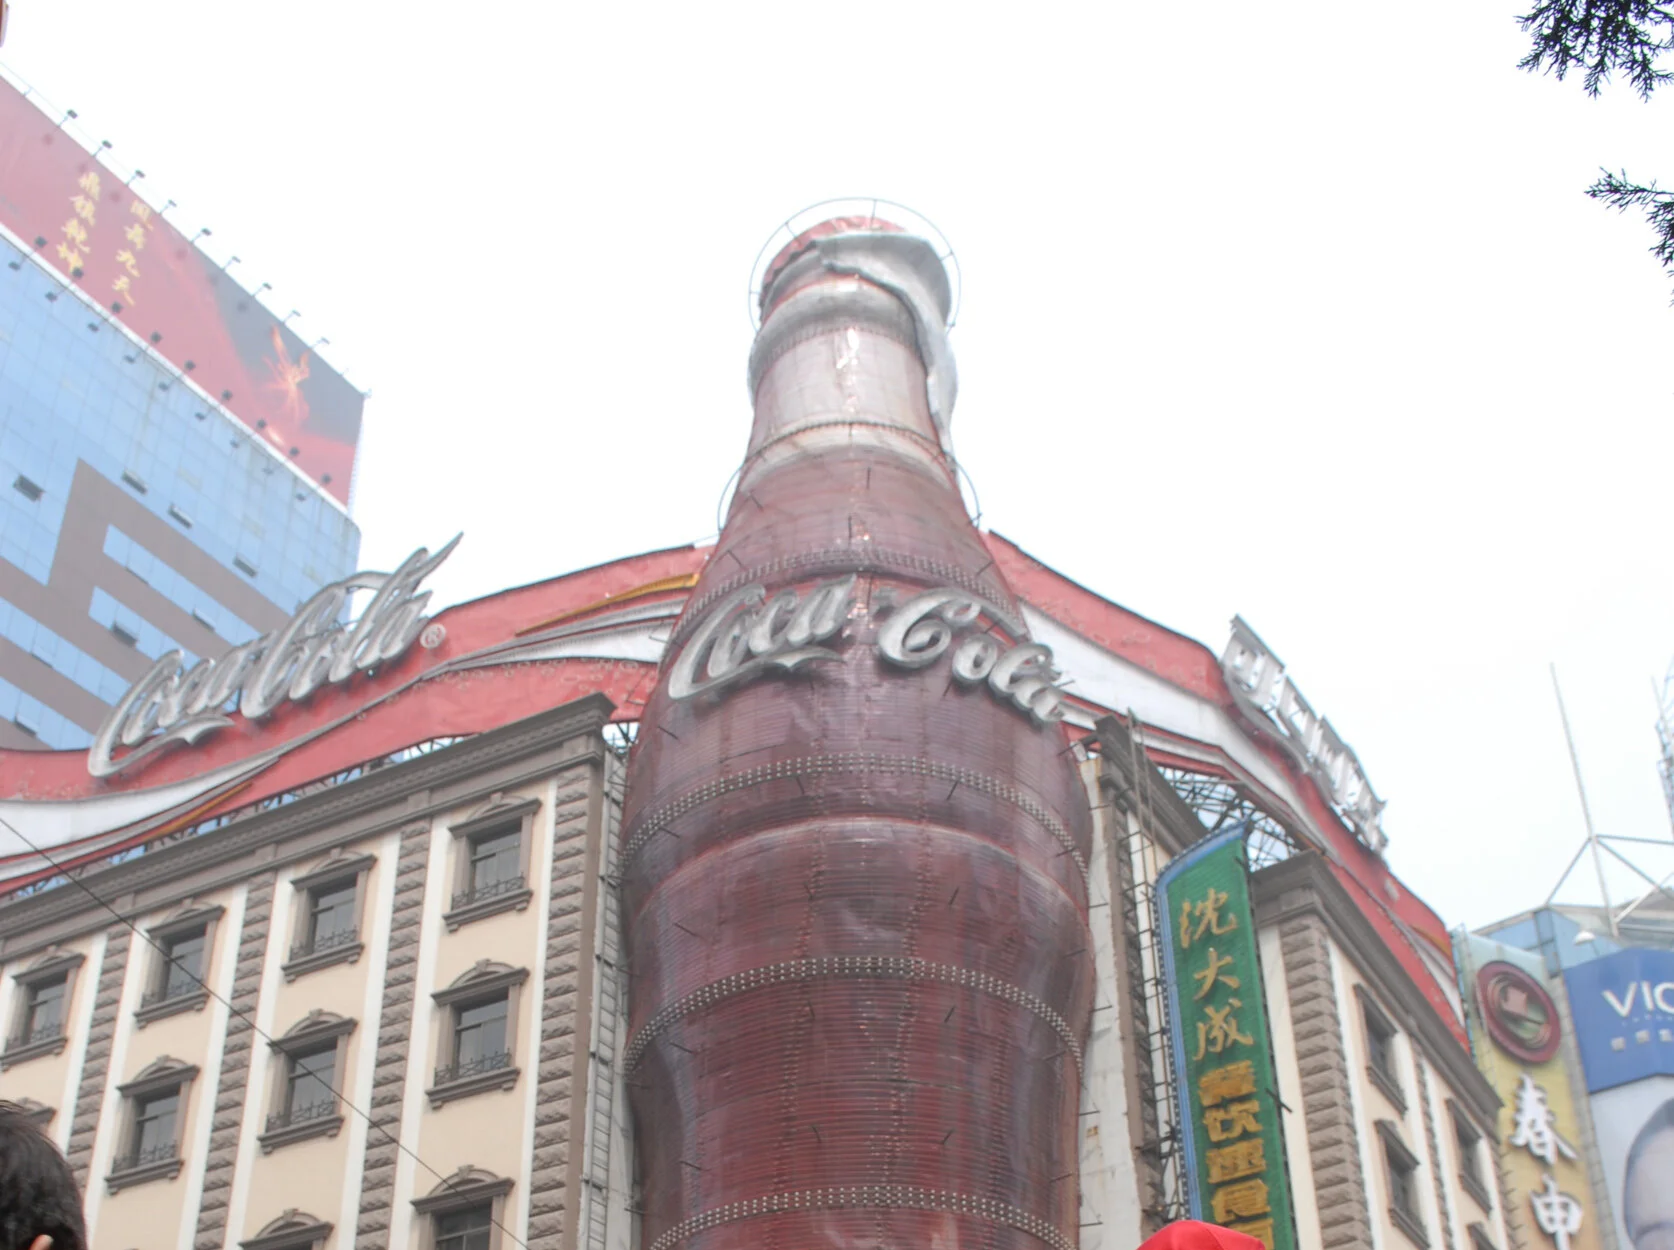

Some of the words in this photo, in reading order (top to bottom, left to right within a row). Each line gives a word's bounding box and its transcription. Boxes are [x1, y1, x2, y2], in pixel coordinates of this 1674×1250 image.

[87, 531, 464, 777] Coca-Cola
[668, 571, 1066, 723] Coca-Cola
[1178, 887, 1255, 1062] 沈大成
